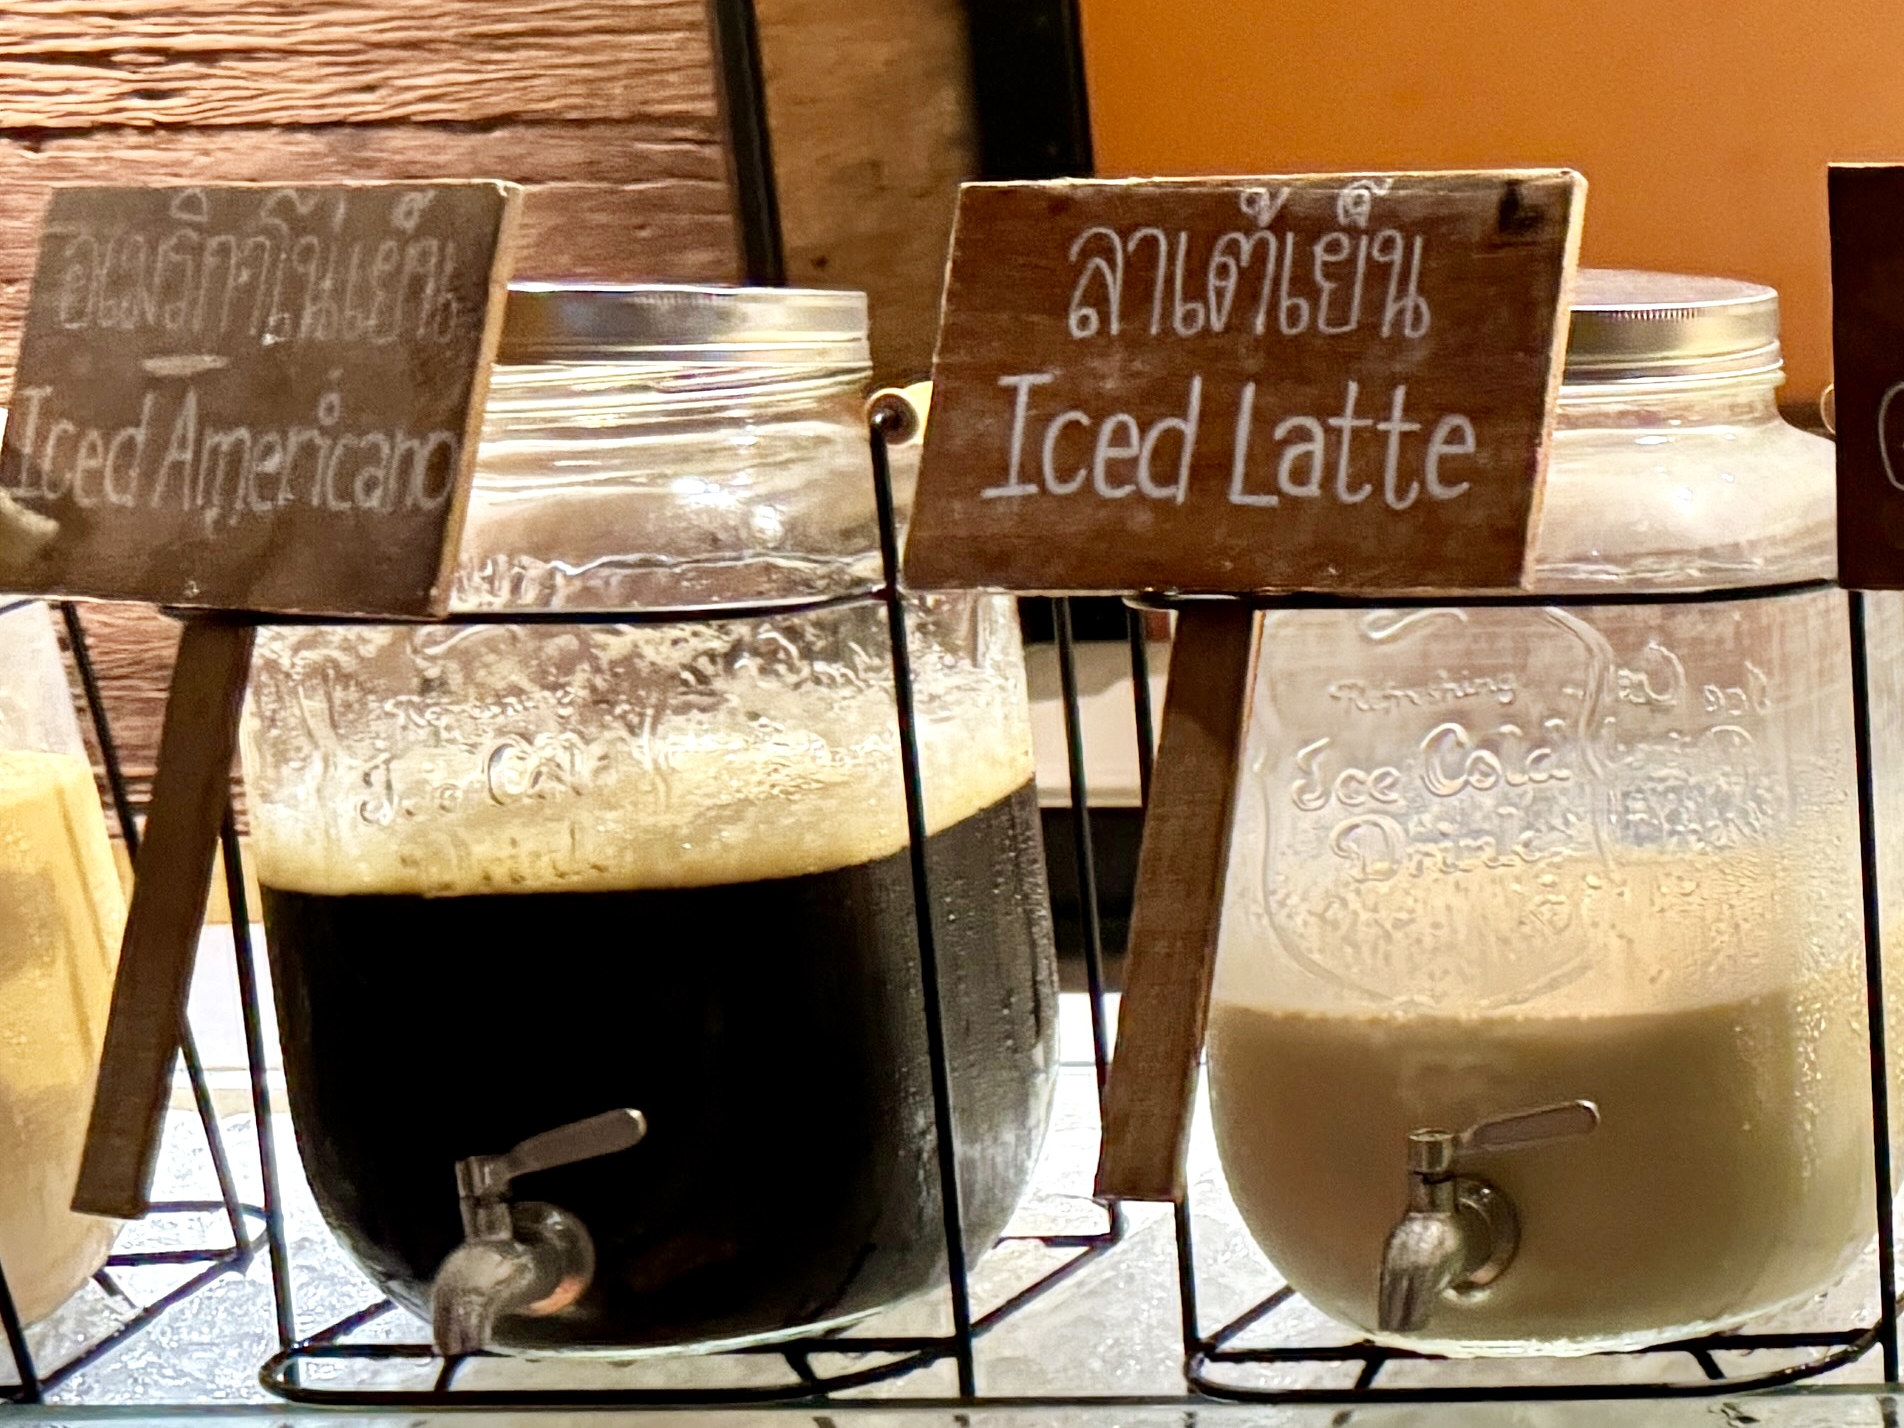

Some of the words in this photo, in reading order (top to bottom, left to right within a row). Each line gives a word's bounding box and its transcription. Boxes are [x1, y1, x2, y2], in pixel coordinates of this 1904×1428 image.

[1068, 178, 1430, 339] ลาเต้เย็น
[10, 385, 154, 509] Iced
[151, 384, 459, 512] Americano
[979, 372, 1201, 505] Iced
[1228, 379, 1477, 510] Latte
